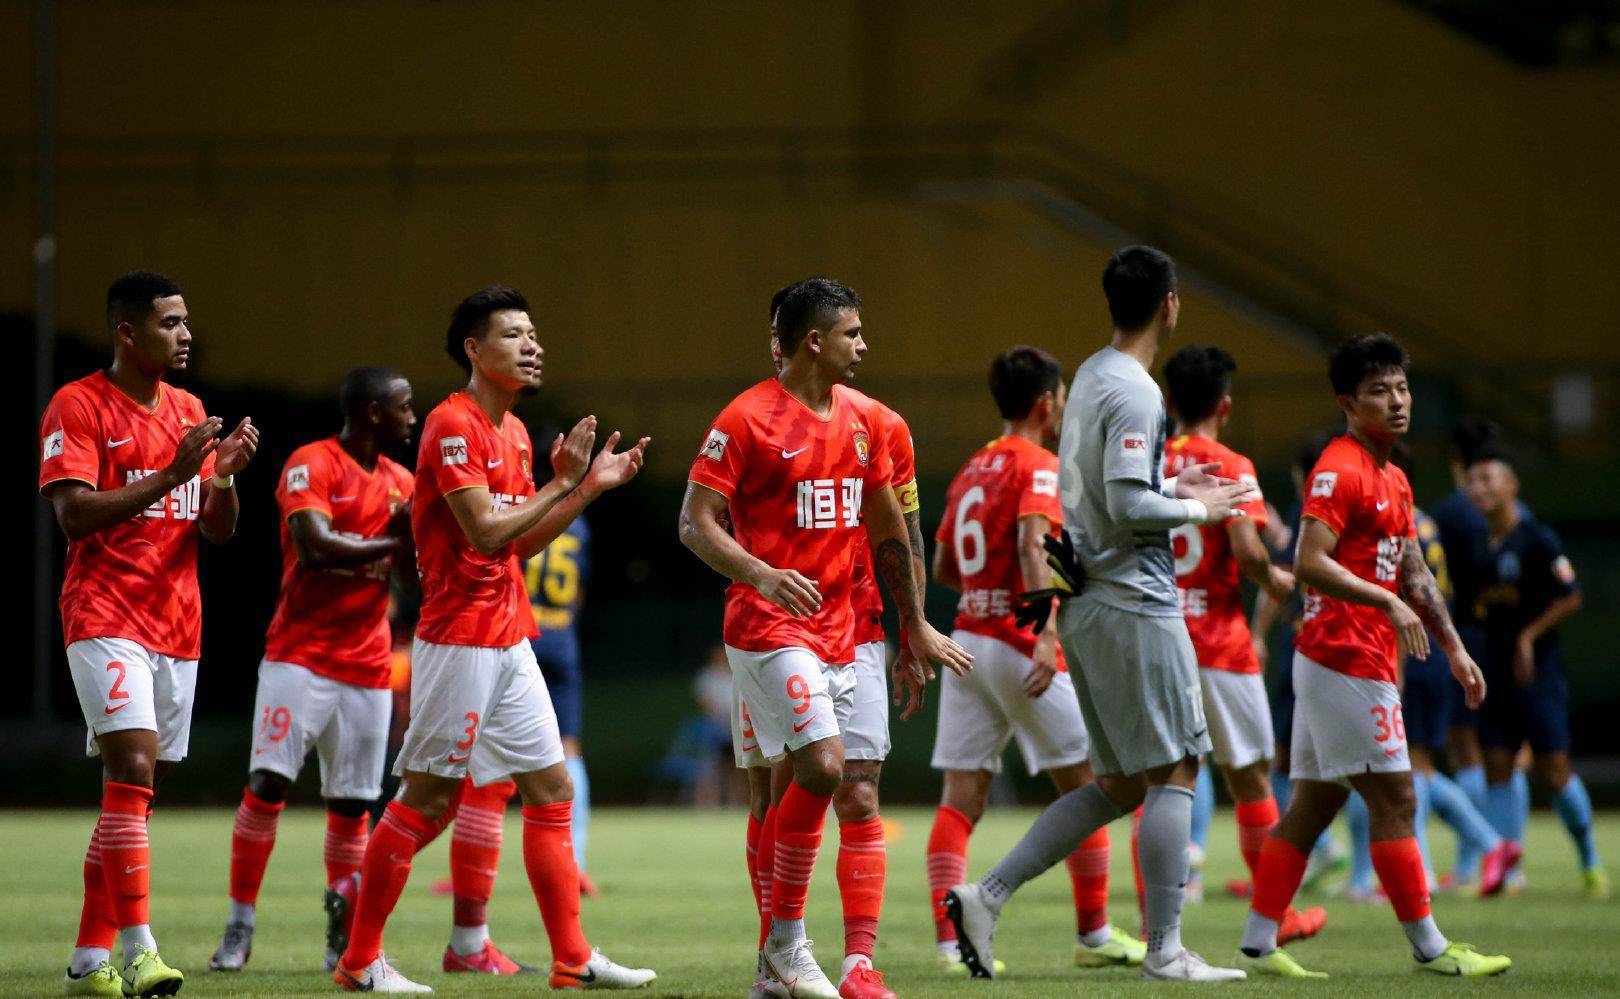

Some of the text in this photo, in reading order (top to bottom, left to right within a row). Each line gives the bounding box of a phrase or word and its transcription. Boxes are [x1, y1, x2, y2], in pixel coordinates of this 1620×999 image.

[954, 486, 985, 576] 6
[106, 660, 130, 700] 2
[785, 674, 809, 715] 9
[261, 706, 292, 743] 19
[457, 711, 479, 750] 3
[1369, 705, 1404, 742] 36
